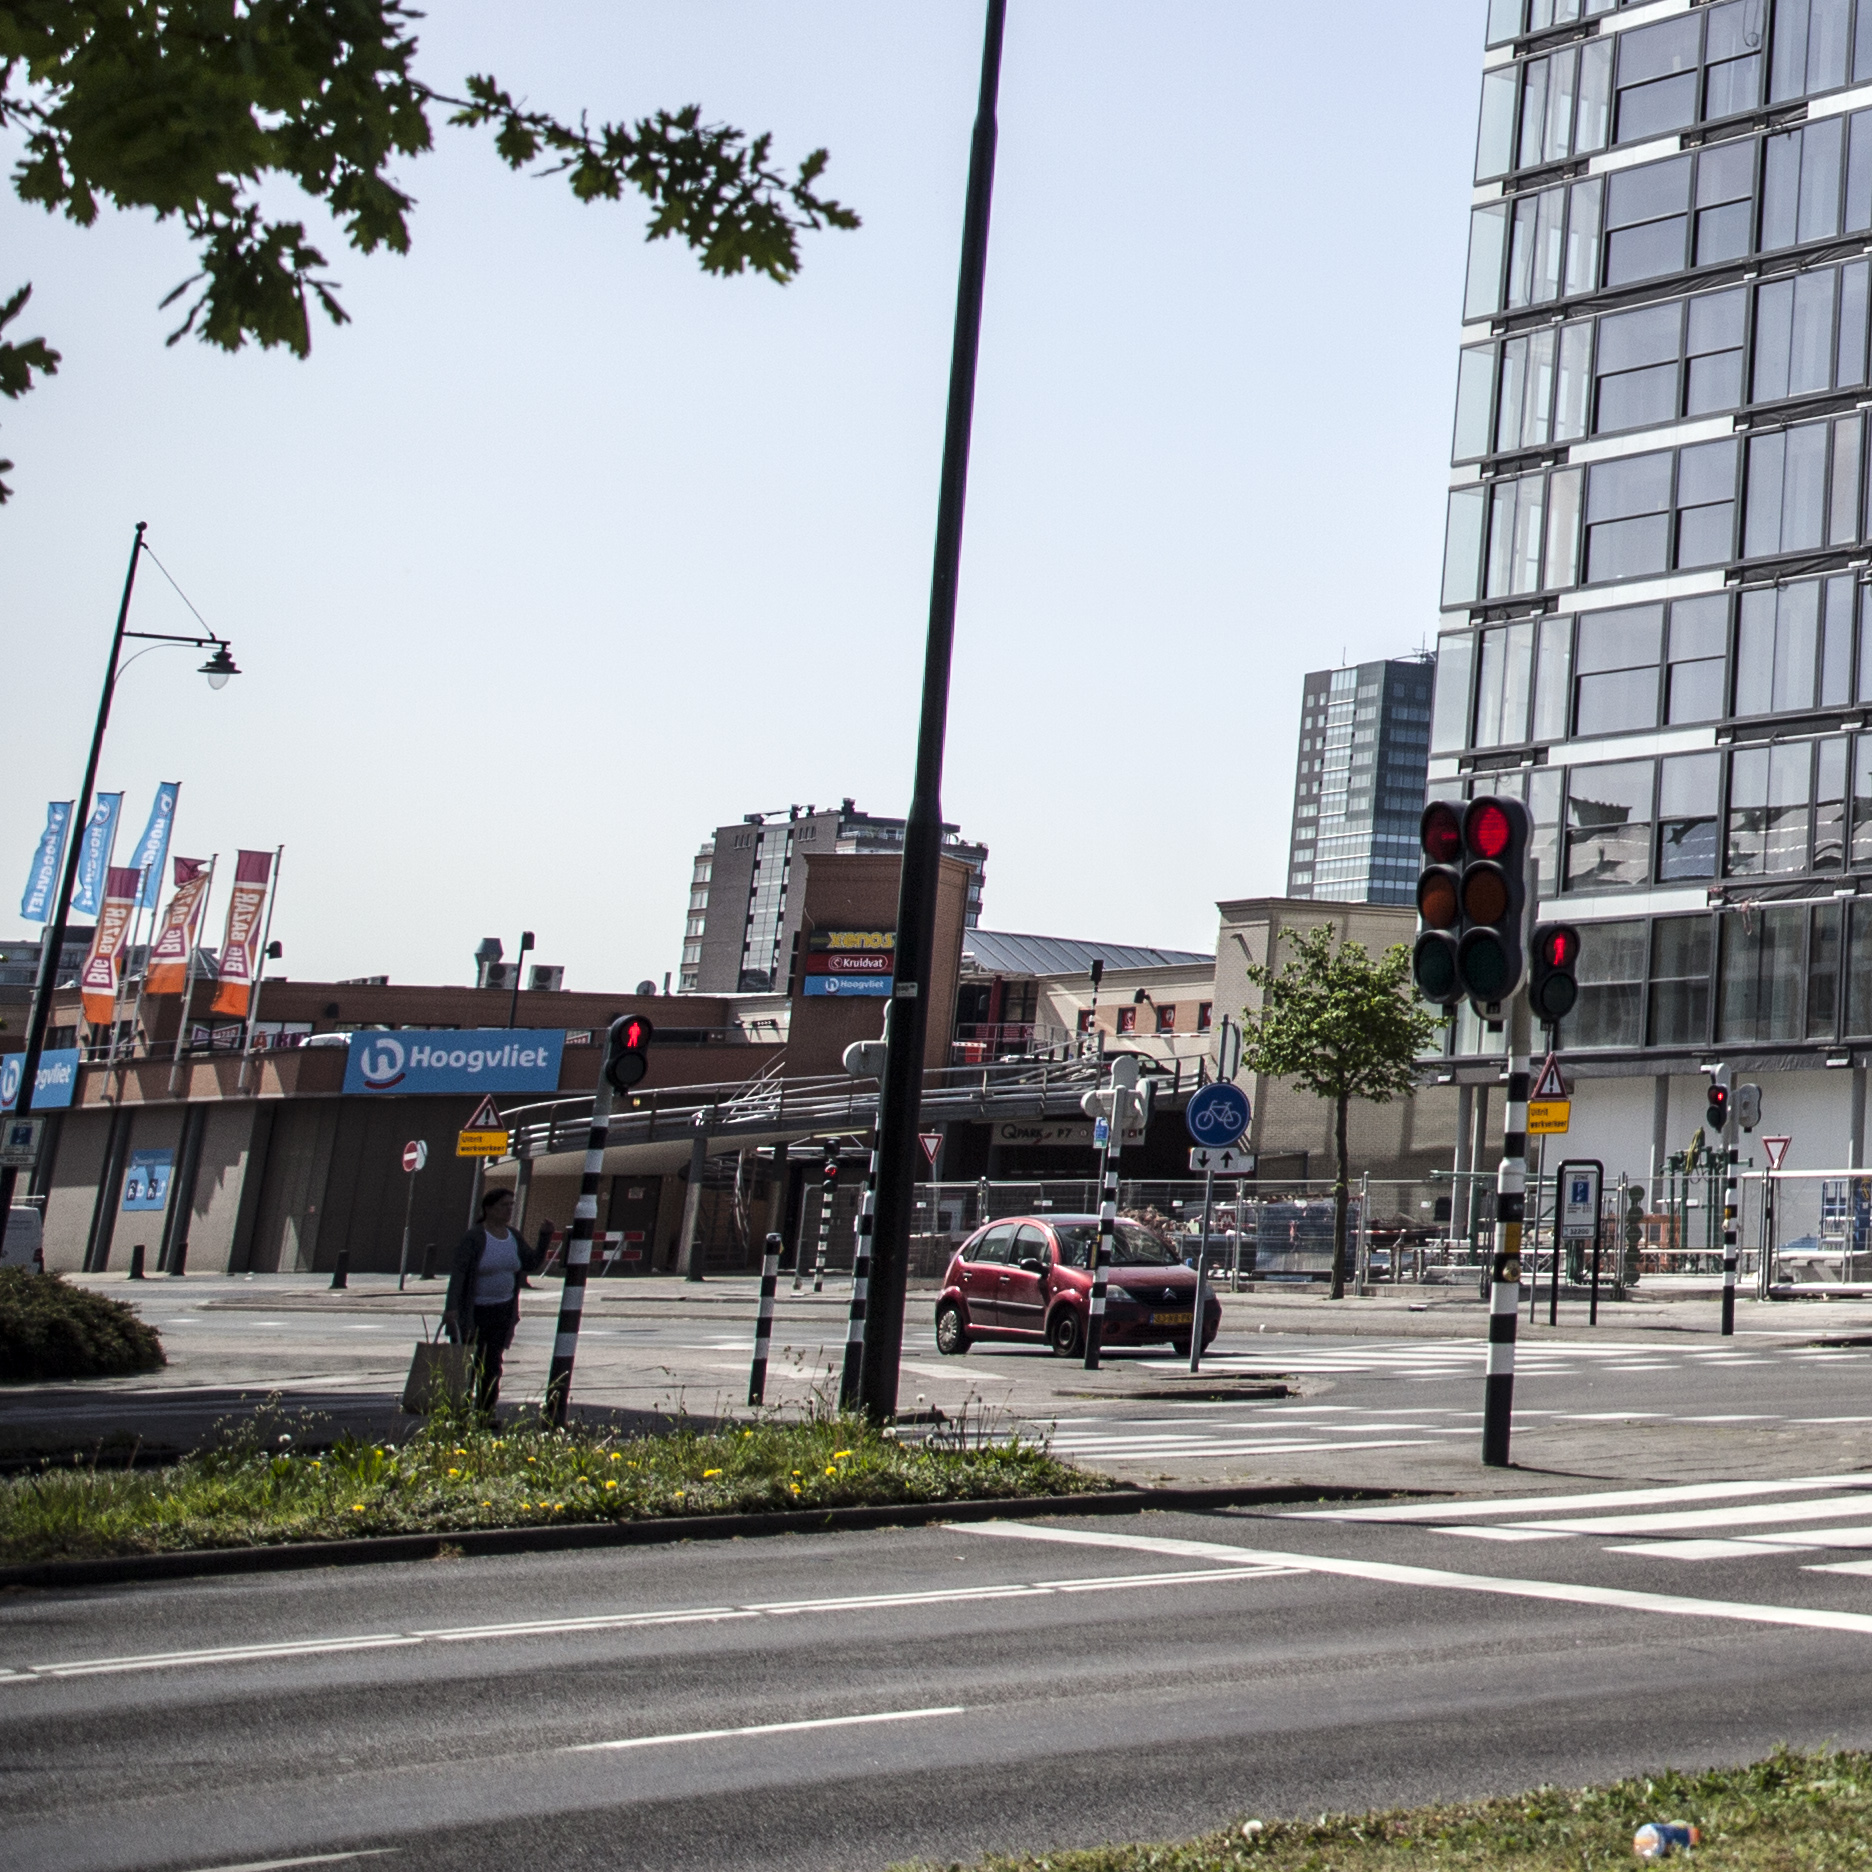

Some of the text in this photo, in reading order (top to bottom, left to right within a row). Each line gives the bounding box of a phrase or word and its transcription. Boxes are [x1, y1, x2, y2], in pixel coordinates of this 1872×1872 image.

[843, 958, 884, 968] Kruidvat
[841, 980, 884, 990] Hoogvliet
[410, 1043, 548, 1073] Hoogvliet
[1530, 1108, 1549, 1117] Uitrit
[1530, 1119, 1567, 1129] werkverkeer
[461, 1134, 483, 1144] Uitrit
[460, 1144, 505, 1154] werkverkeer
